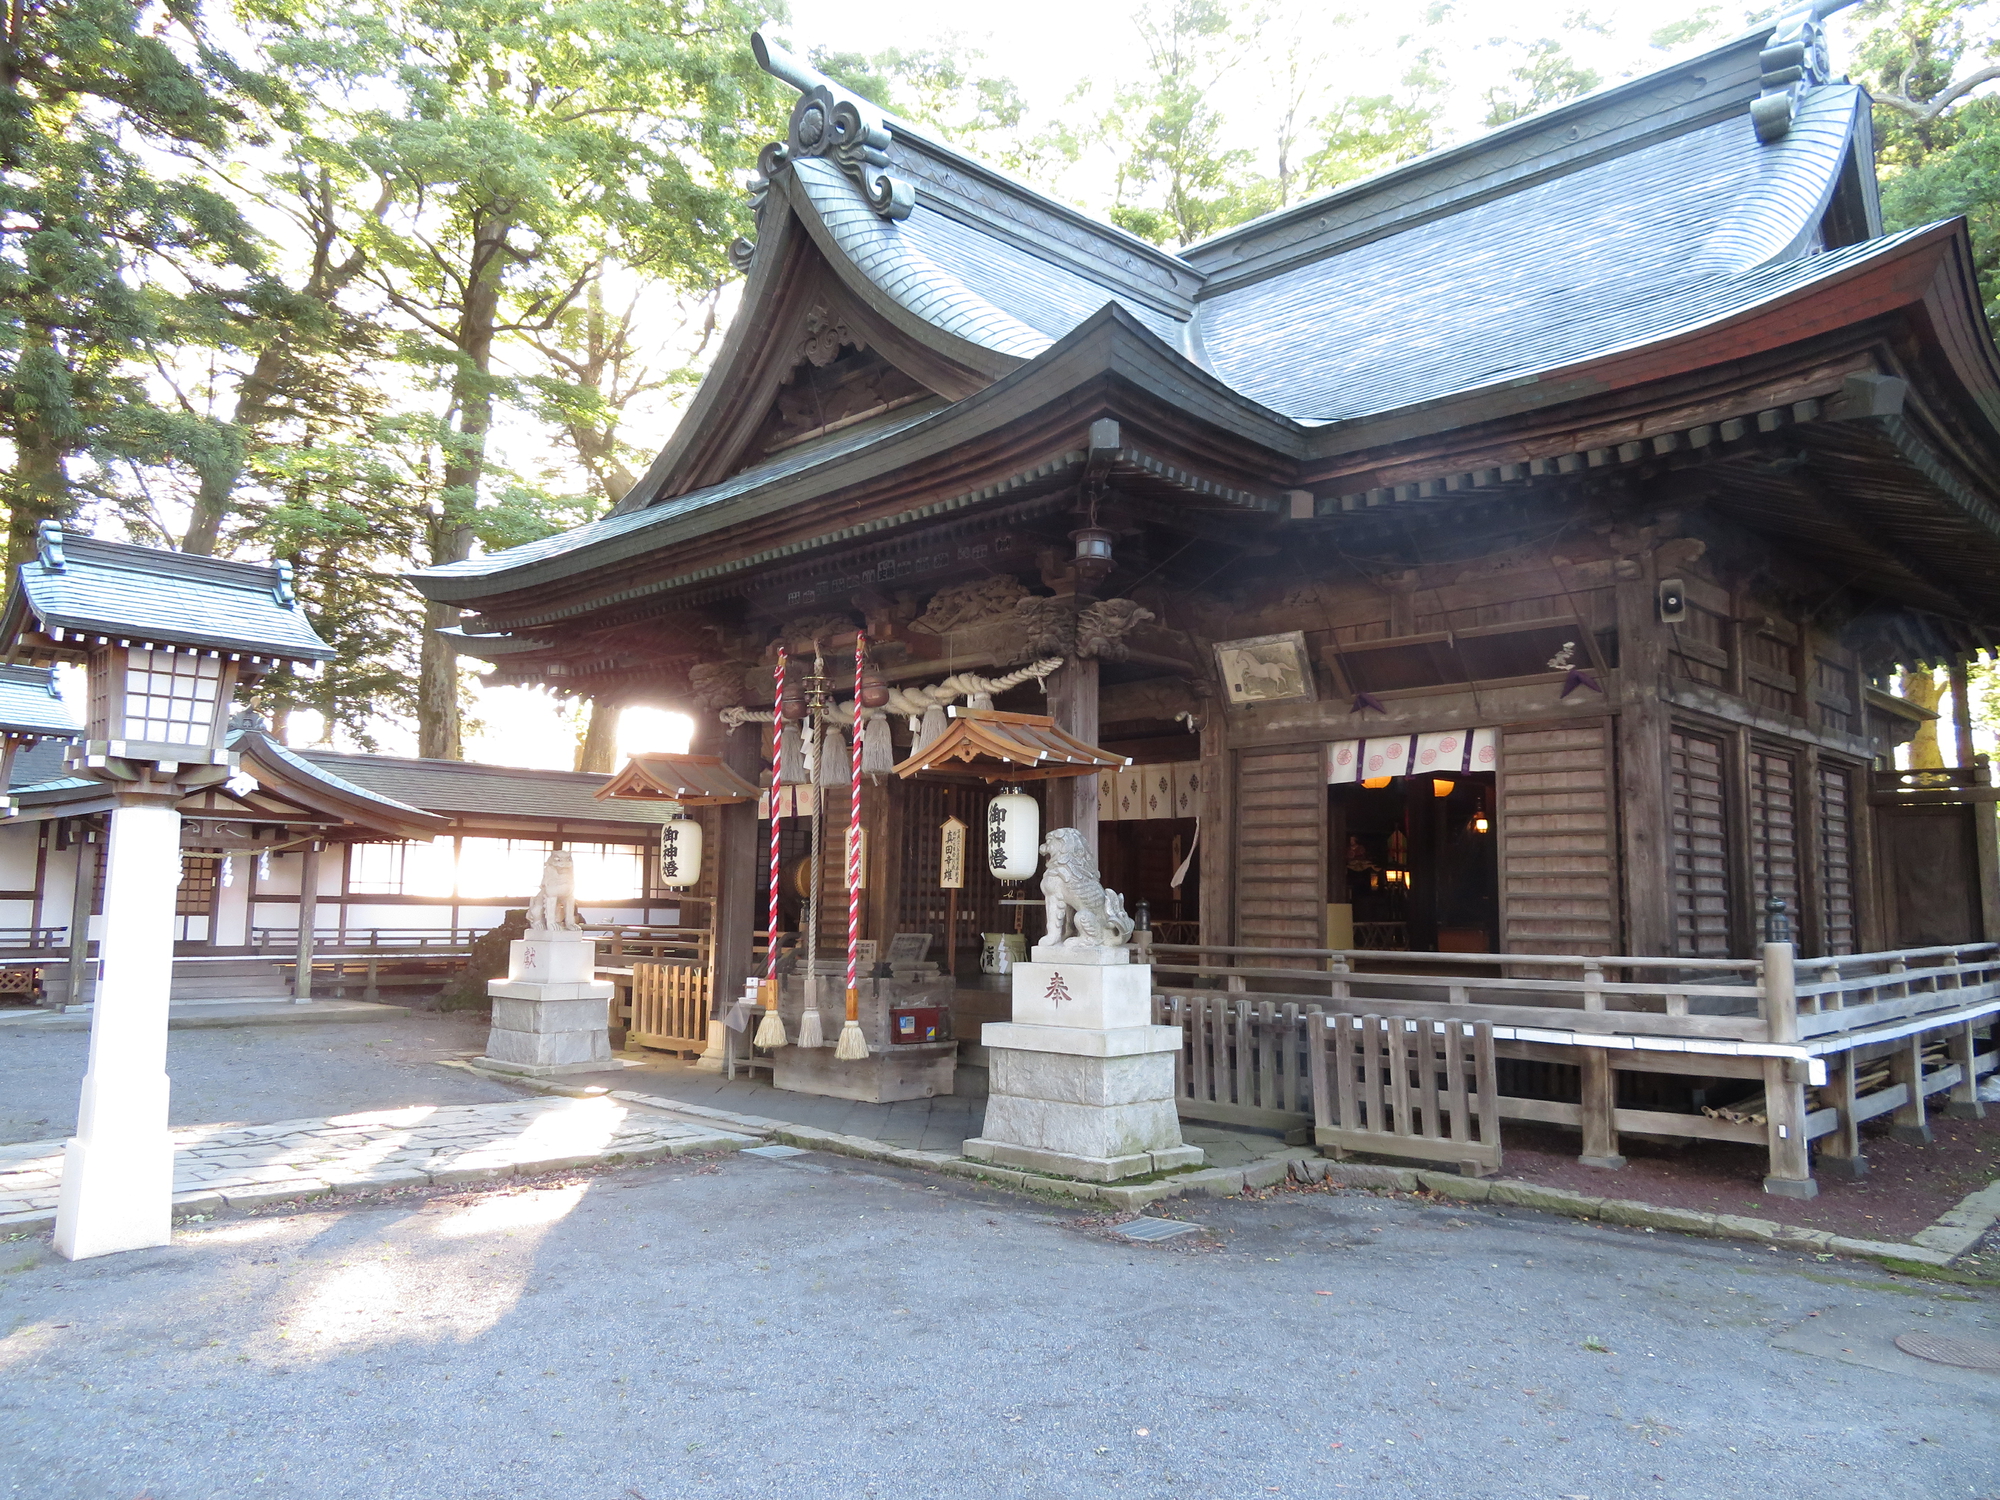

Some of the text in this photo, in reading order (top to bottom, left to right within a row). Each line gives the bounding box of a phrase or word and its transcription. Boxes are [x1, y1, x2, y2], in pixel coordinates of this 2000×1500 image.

[663, 826, 679, 877] 御神燈
[943, 830, 953, 882] 真田幸雄
[989, 803, 1008, 869] 御神燈
[1043, 971, 1072, 1009] 奉
